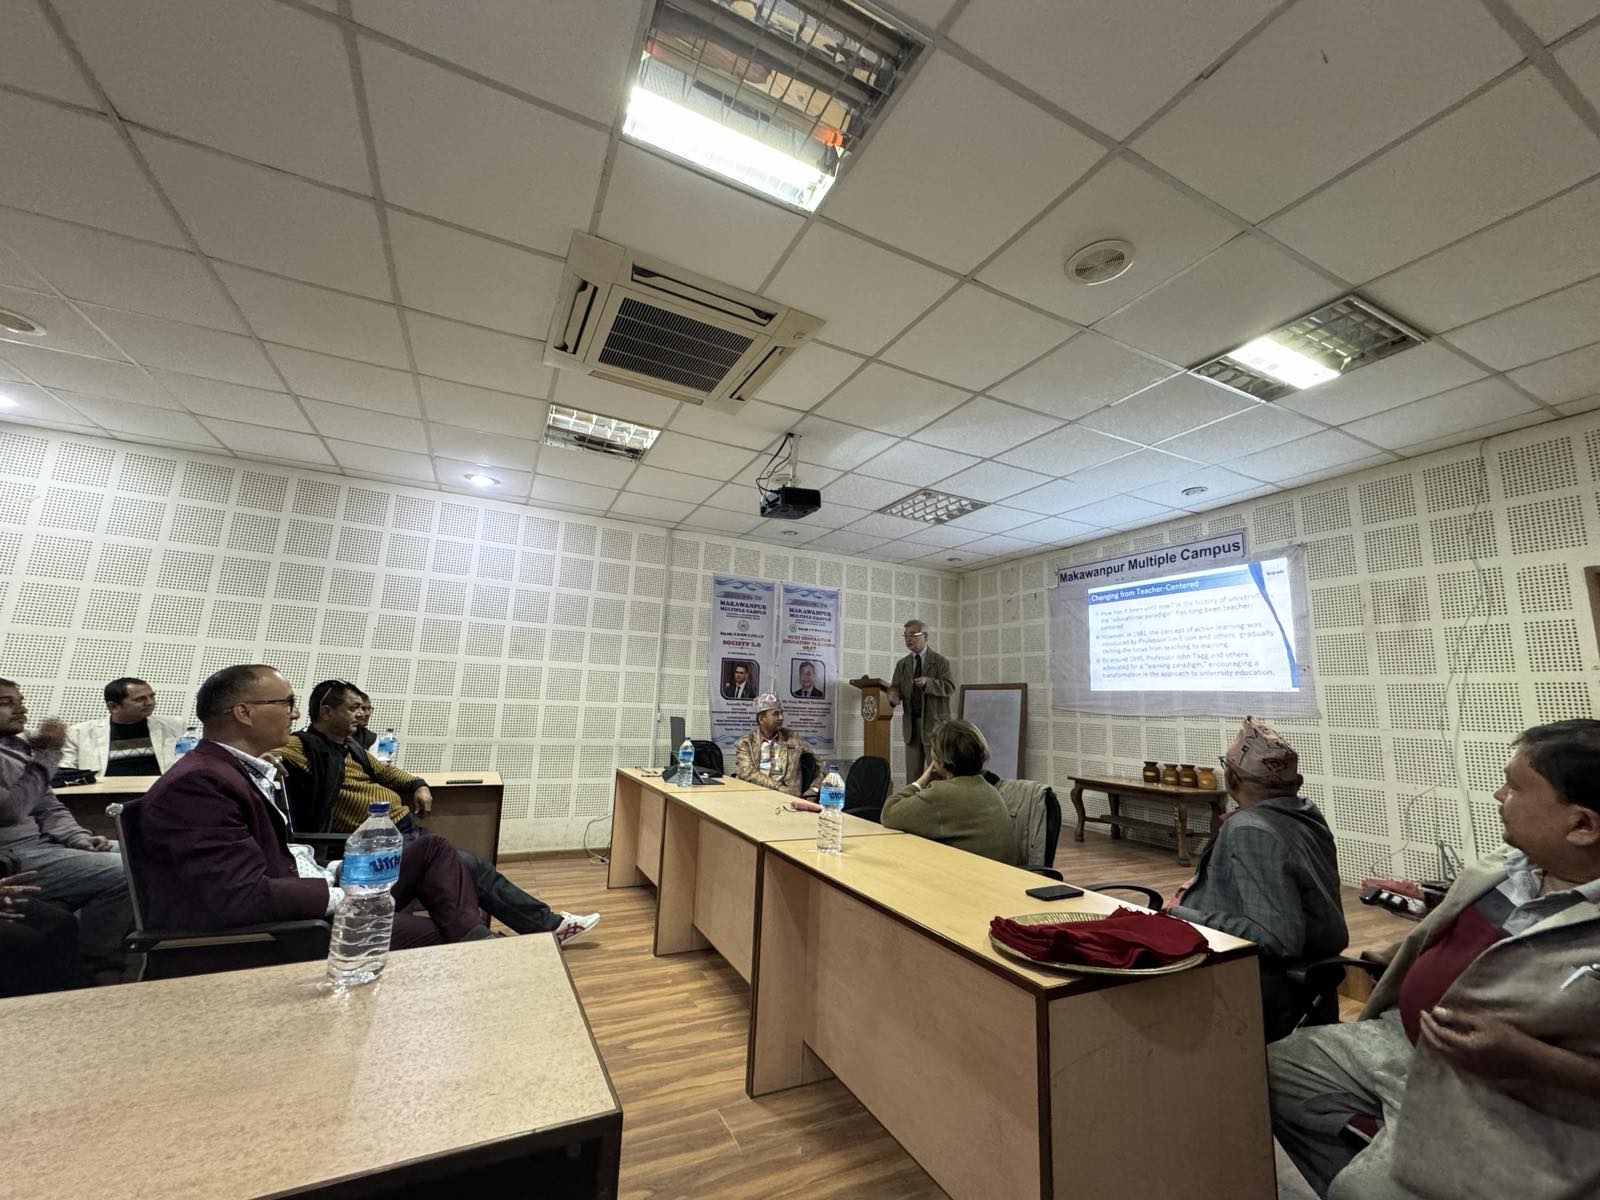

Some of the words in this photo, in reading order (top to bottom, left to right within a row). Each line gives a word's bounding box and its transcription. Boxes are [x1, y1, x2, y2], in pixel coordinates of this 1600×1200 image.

[1059, 563, 1125, 583] Makawanpur
[1128, 553, 1177, 571] Multiple
[1180, 541, 1241, 561] Campus
[1091, 591, 1119, 602] Changing
[1136, 581, 1199, 595] Teacher-Centered
[720, 600, 767, 610] MAKAWANPUR
[720, 606, 745, 614] MULTIPLE
[789, 607, 832, 617] MAKAWANPUR
[1215, 623, 1245, 631] learning
[1239, 630, 1275, 639] gradually
[1192, 652, 1209, 660] Tagg
